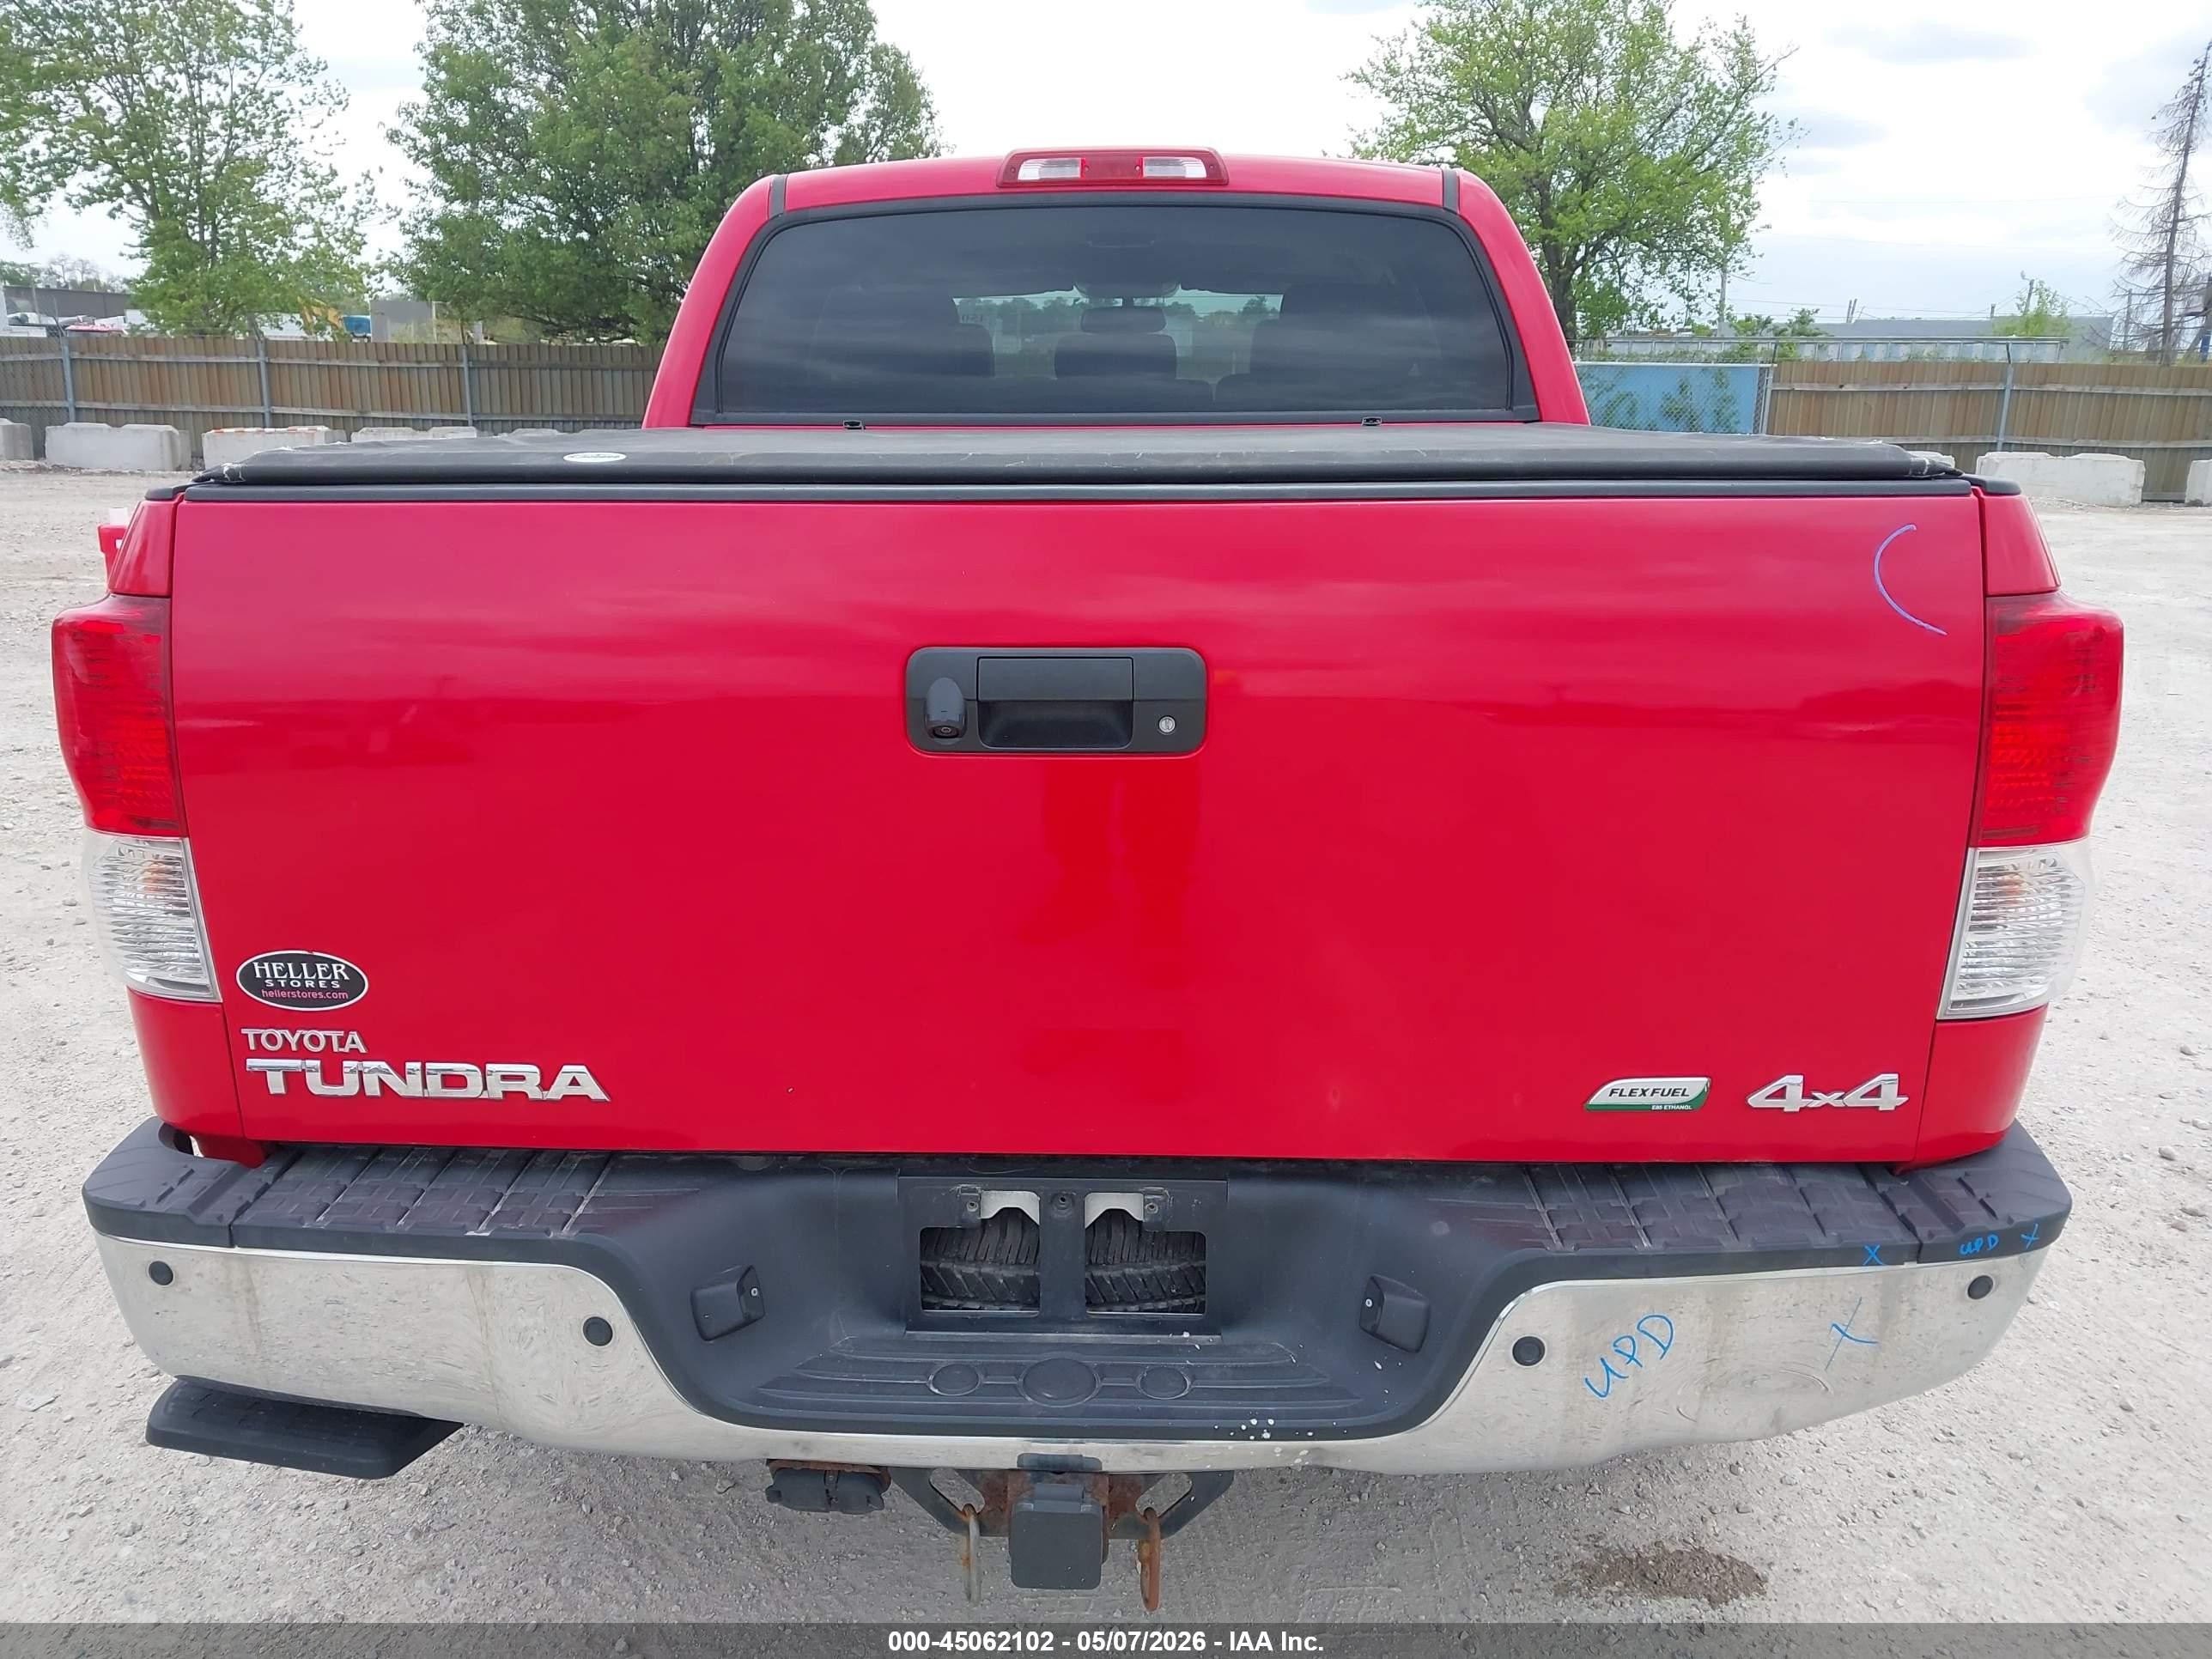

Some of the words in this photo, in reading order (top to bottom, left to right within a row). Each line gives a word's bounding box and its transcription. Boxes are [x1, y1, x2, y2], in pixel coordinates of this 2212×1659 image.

[252, 961, 349, 981] HELLER
[261, 988, 349, 1000] hellerstores.com
[264, 978, 341, 989] STORES
[241, 1028, 368, 1053] TOYOTA
[246, 1058, 611, 1102] TUNDRA
[1747, 1073, 1909, 1112] 4x4
